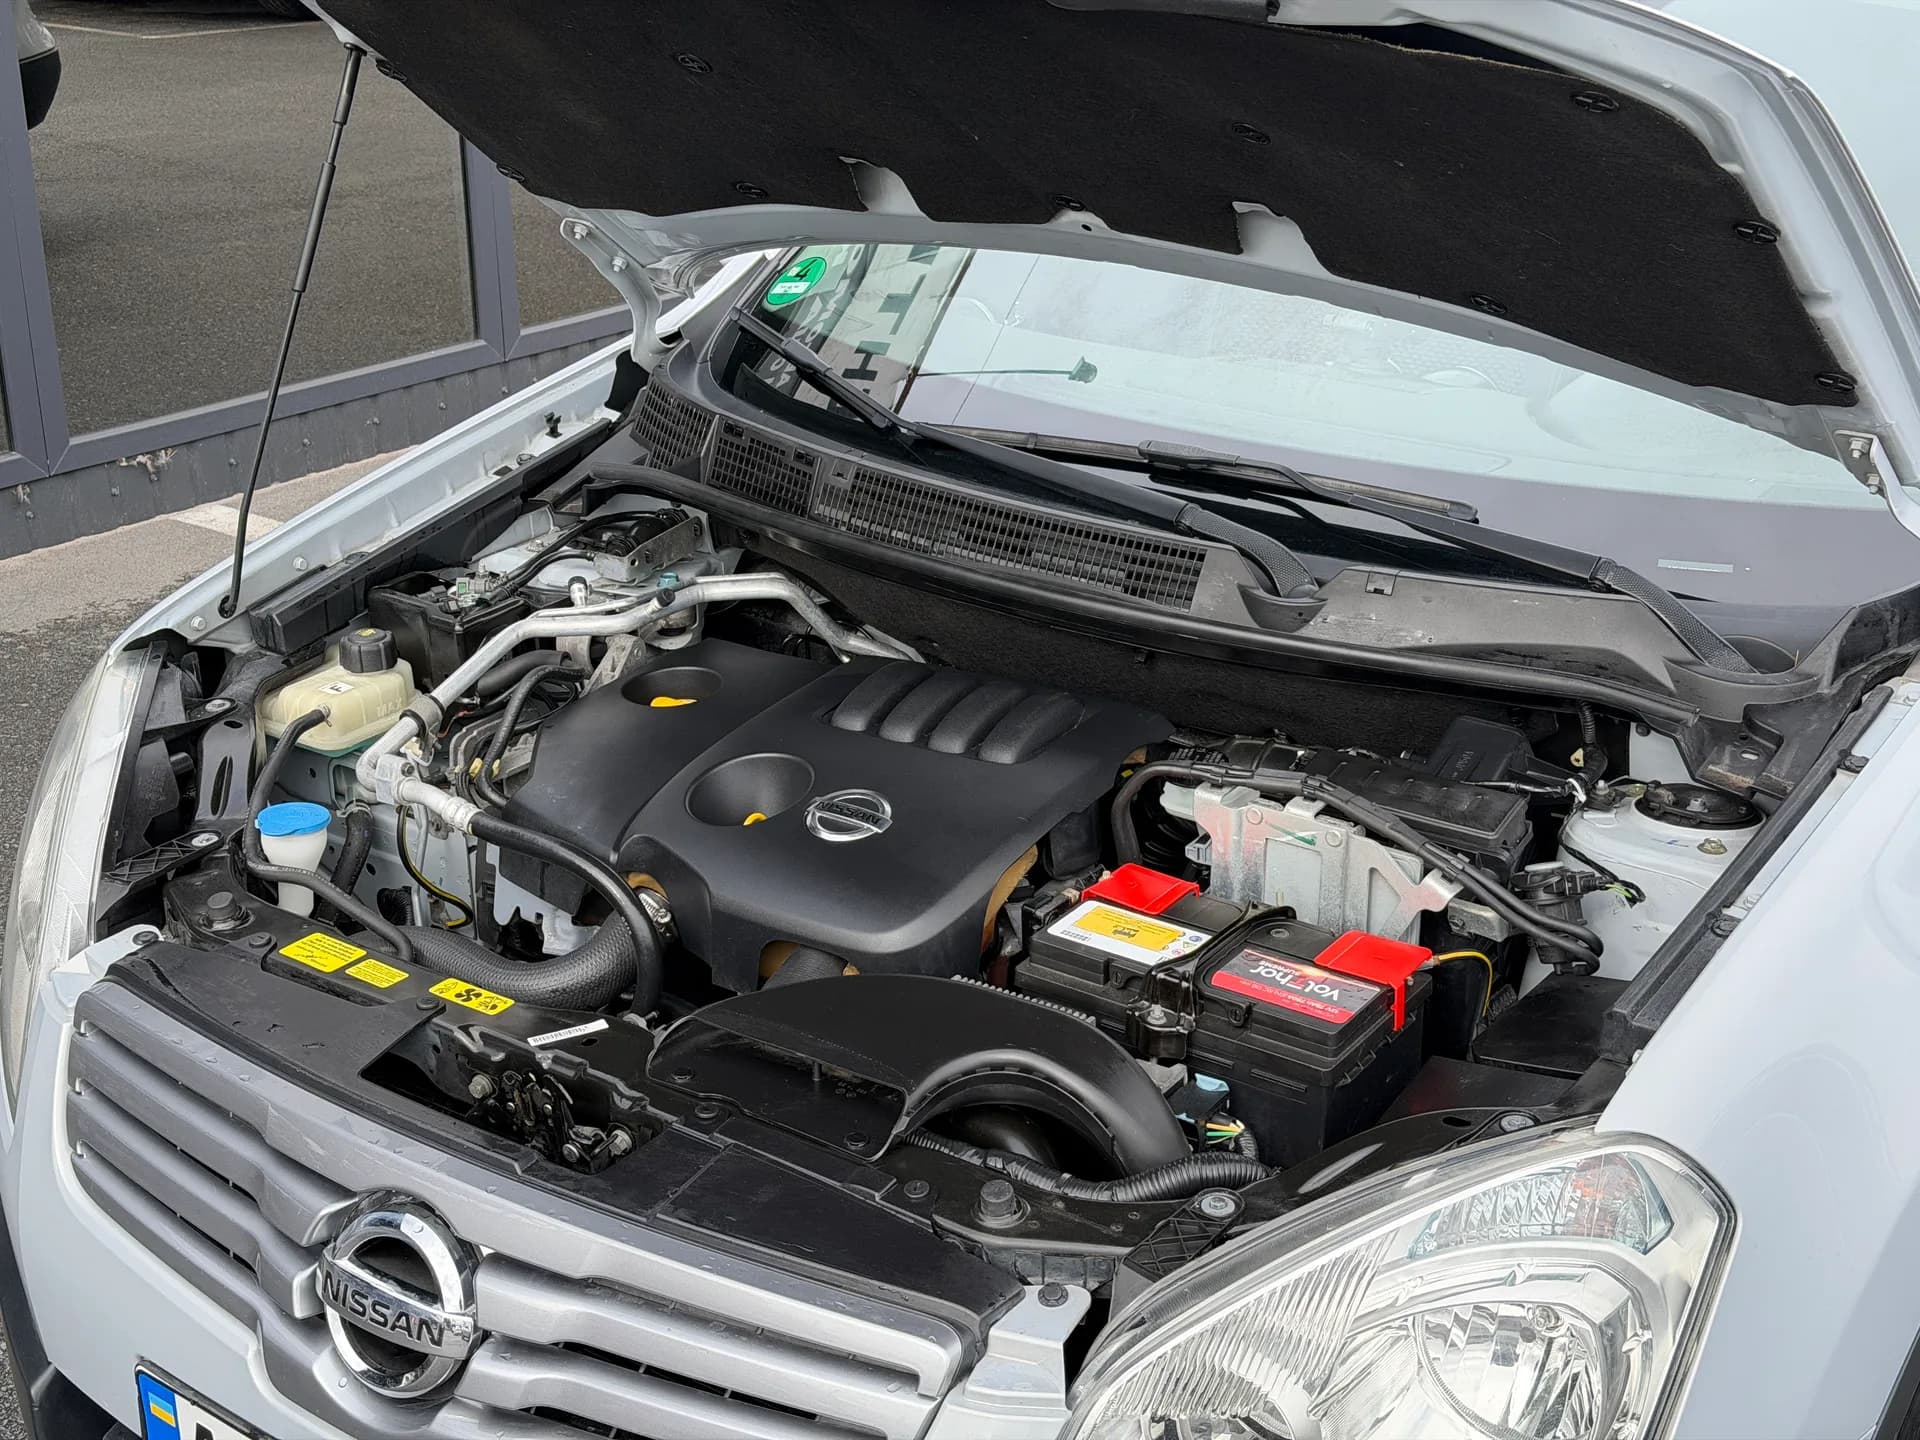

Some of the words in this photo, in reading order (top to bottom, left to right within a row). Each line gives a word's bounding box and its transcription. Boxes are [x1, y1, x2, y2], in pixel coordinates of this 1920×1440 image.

[793, 258, 817, 280] 4
[815, 801, 880, 826] NISSAN
[322, 1269, 444, 1348] NISSAN
